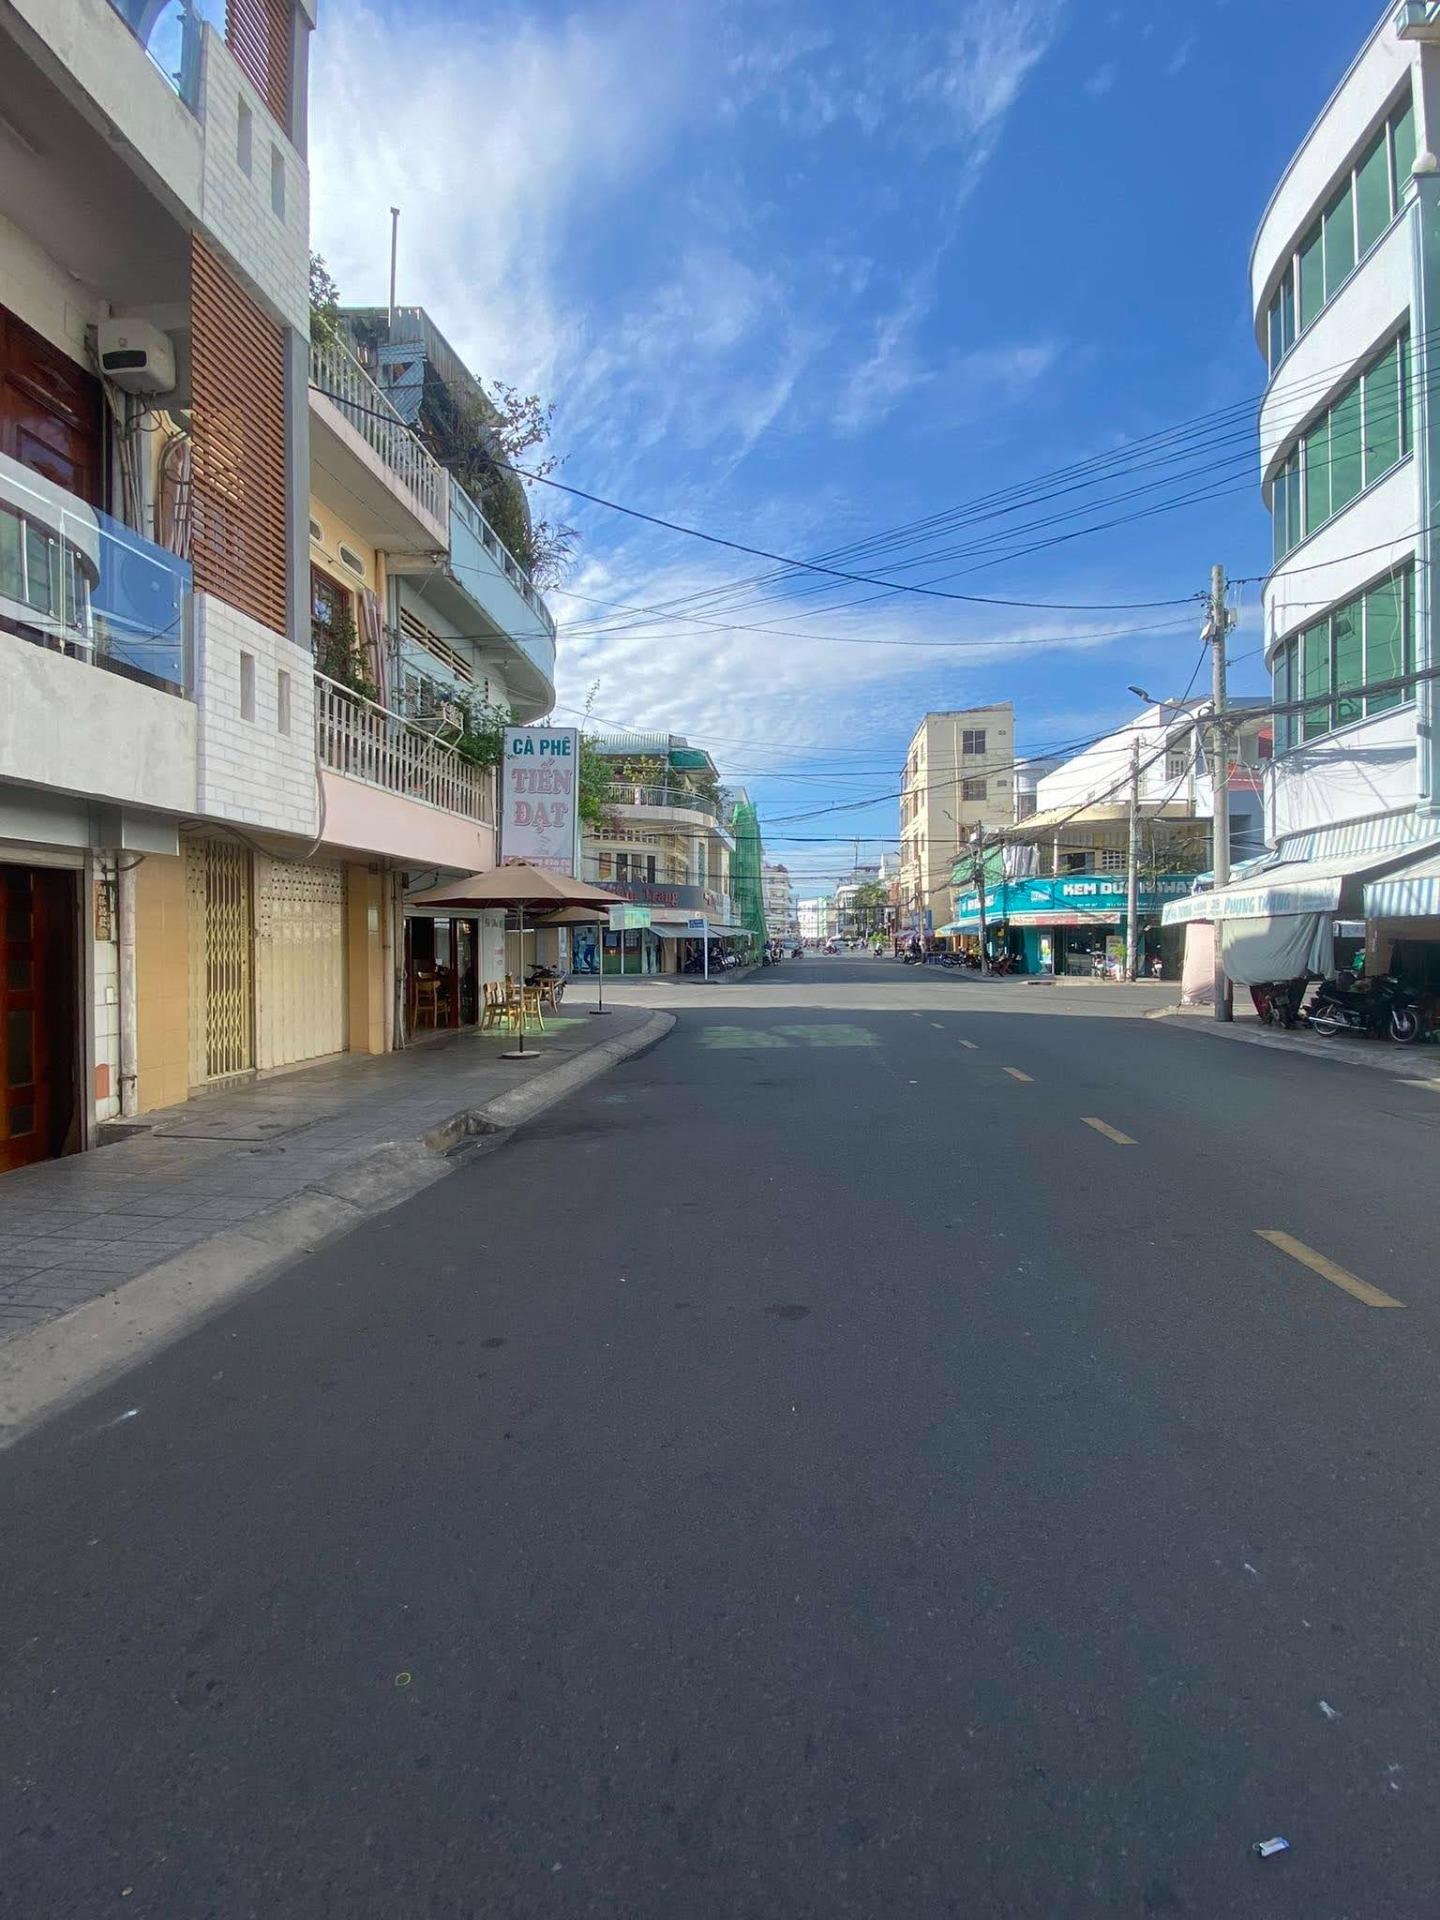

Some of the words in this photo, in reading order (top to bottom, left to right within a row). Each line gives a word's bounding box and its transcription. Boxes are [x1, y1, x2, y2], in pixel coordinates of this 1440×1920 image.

[513, 735, 535, 756] CÀ
[539, 736, 571, 756] PHÊ
[512, 758, 573, 795] TIẾN
[513, 800, 569, 834] ĐẠT
[1063, 882, 1097, 896] KEM
